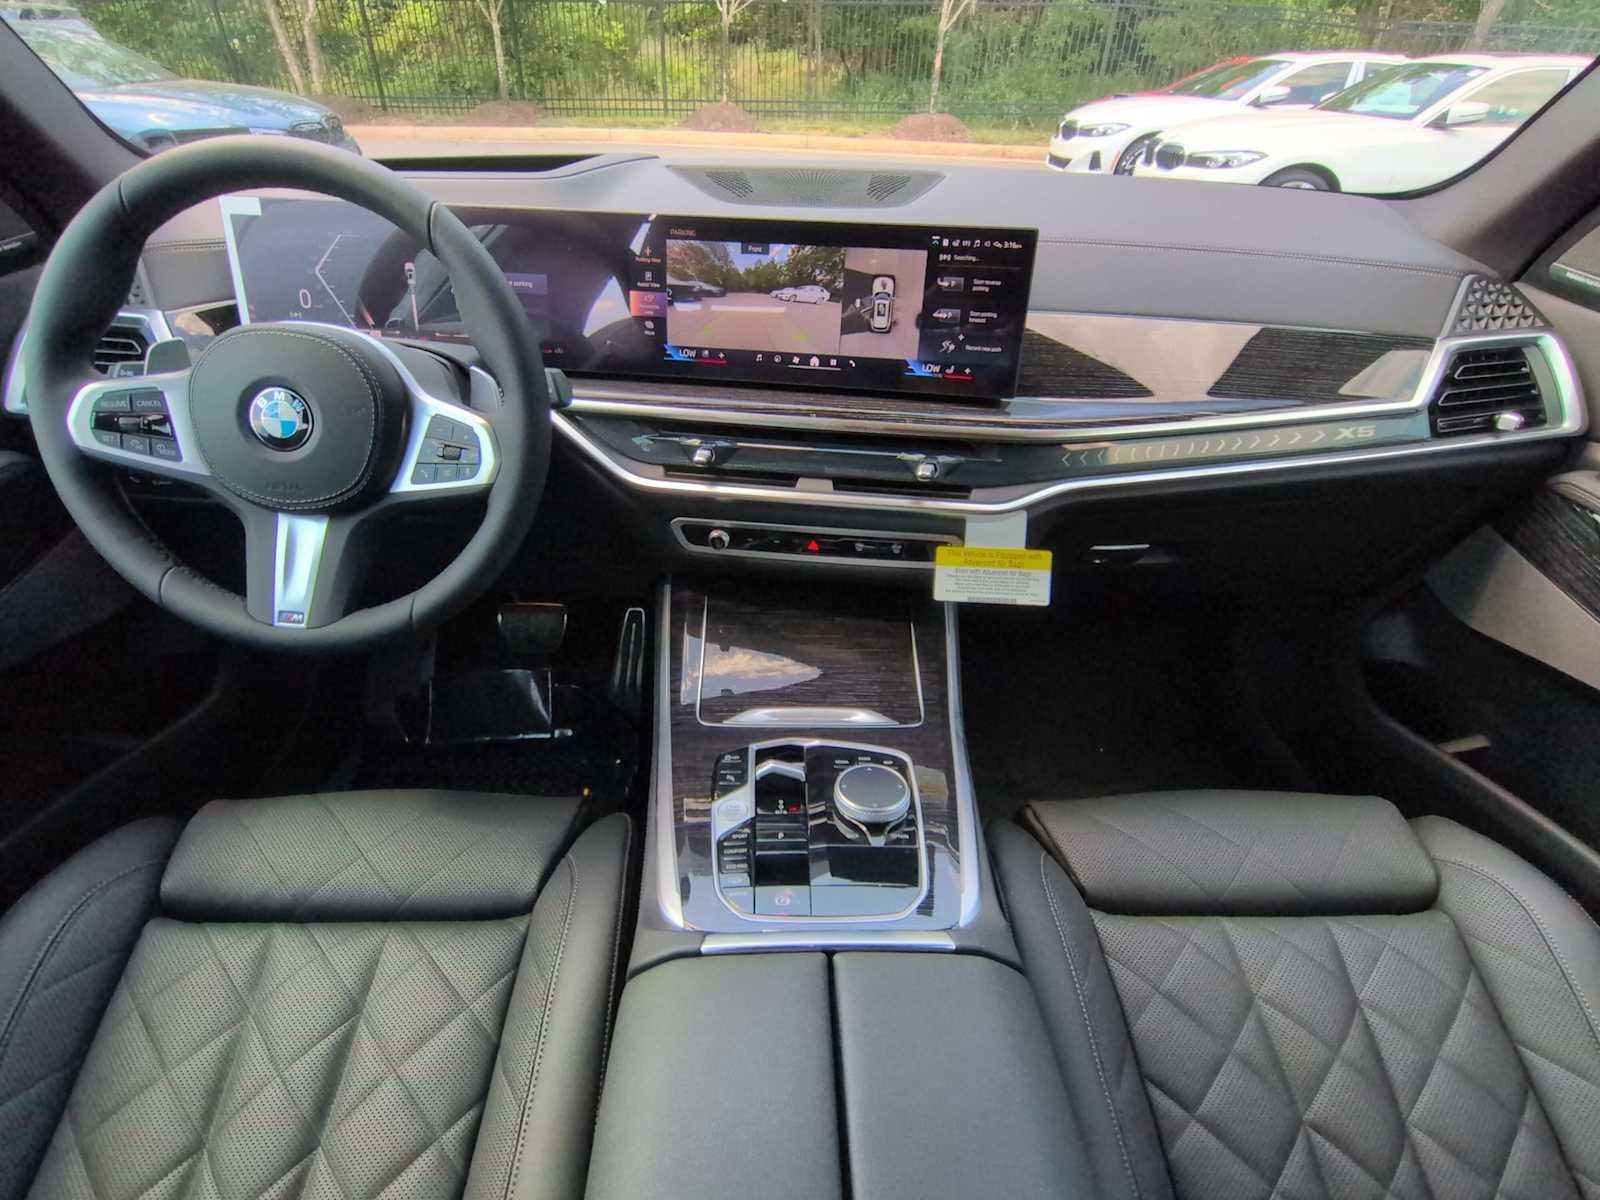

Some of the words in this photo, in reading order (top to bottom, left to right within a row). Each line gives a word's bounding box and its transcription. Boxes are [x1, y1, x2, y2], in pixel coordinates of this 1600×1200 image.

[680, 348, 697, 358] LOW
[921, 364, 941, 373] LOW
[256, 391, 305, 413] BMW
[1334, 425, 1377, 441] X5
